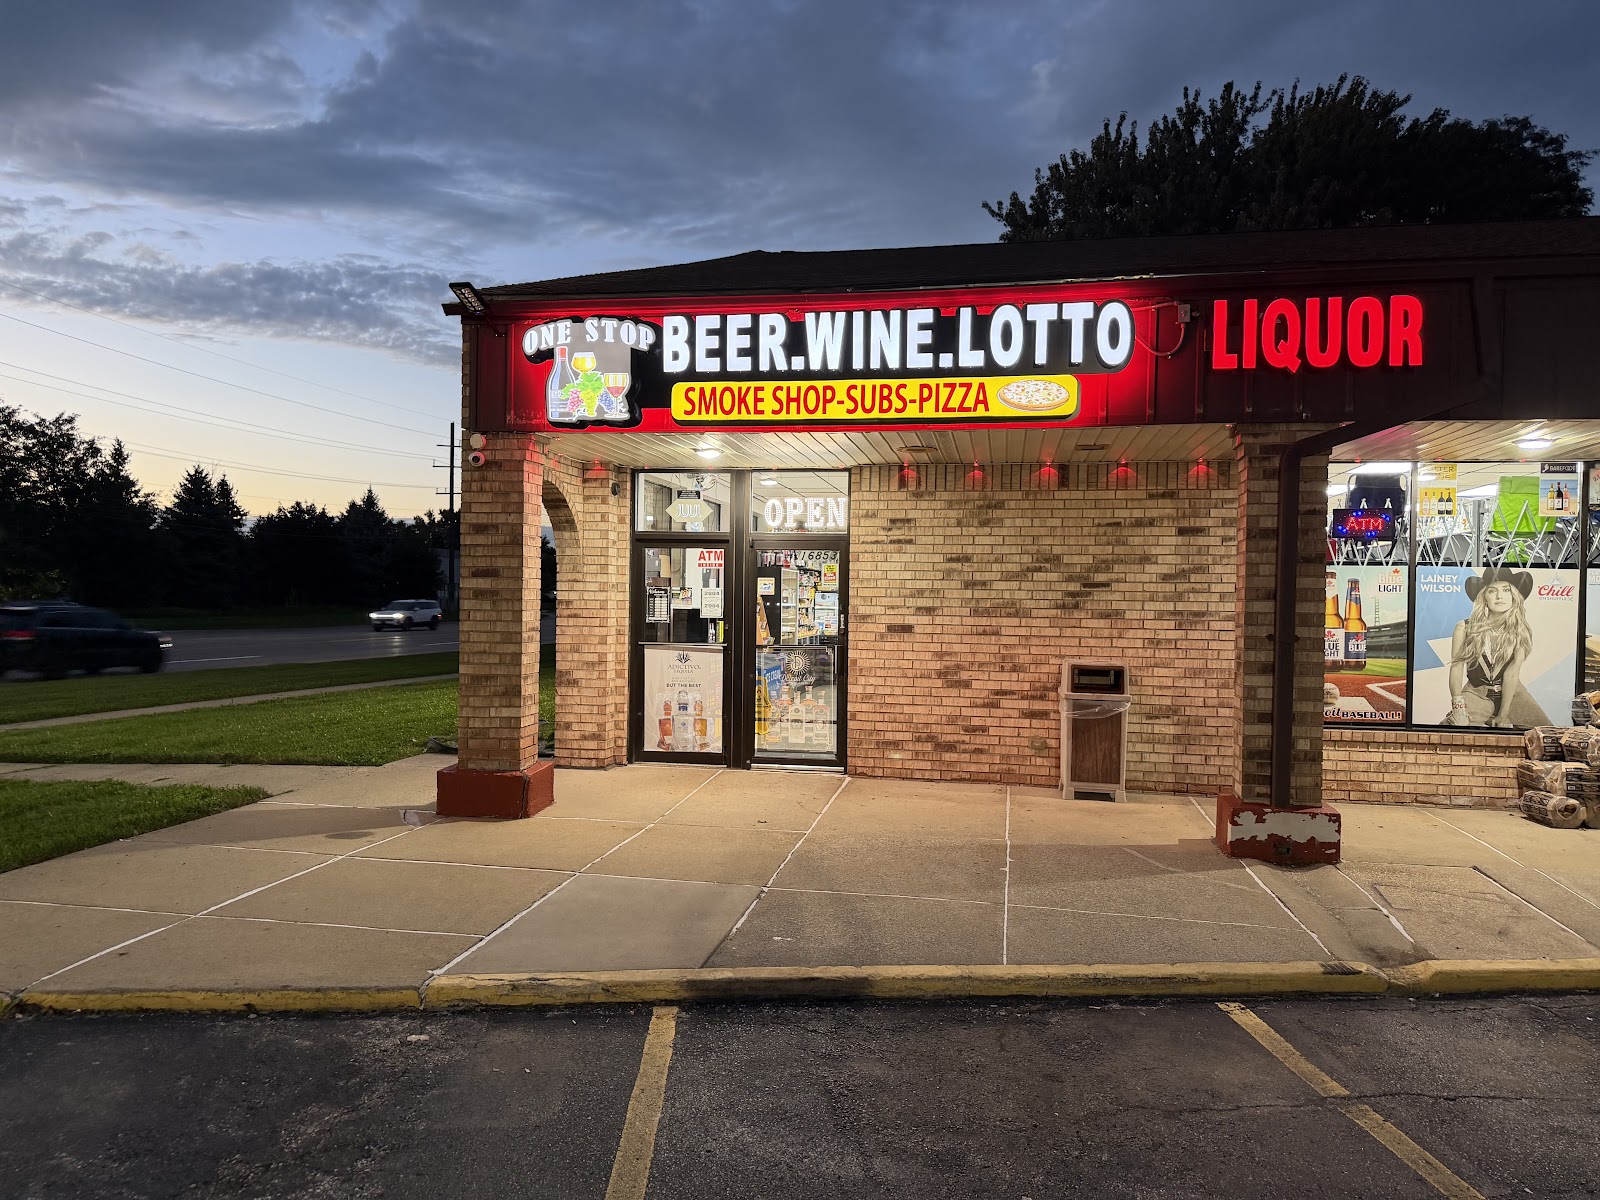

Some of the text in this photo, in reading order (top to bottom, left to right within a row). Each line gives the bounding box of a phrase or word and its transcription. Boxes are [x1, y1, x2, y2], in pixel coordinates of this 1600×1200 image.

[523, 319, 655, 353] ONE STOP
[1212, 295, 1423, 373] LIQUOR
[684, 386, 765, 416] SMOKE
[676, 503, 702, 518] JUUL
[765, 497, 846, 528] OPEN
[1346, 516, 1383, 531] ATM
[698, 550, 724, 562] ATM
[802, 551, 838, 561] 16853
[1379, 573, 1403, 585] Blue
[1421, 575, 1458, 583] LAINEY
[1379, 585, 1403, 593] LIGHT
[1420, 584, 1461, 593] WILSON
[1538, 585, 1575, 597] Chill
[1341, 710, 1402, 719] BASEBALL!
